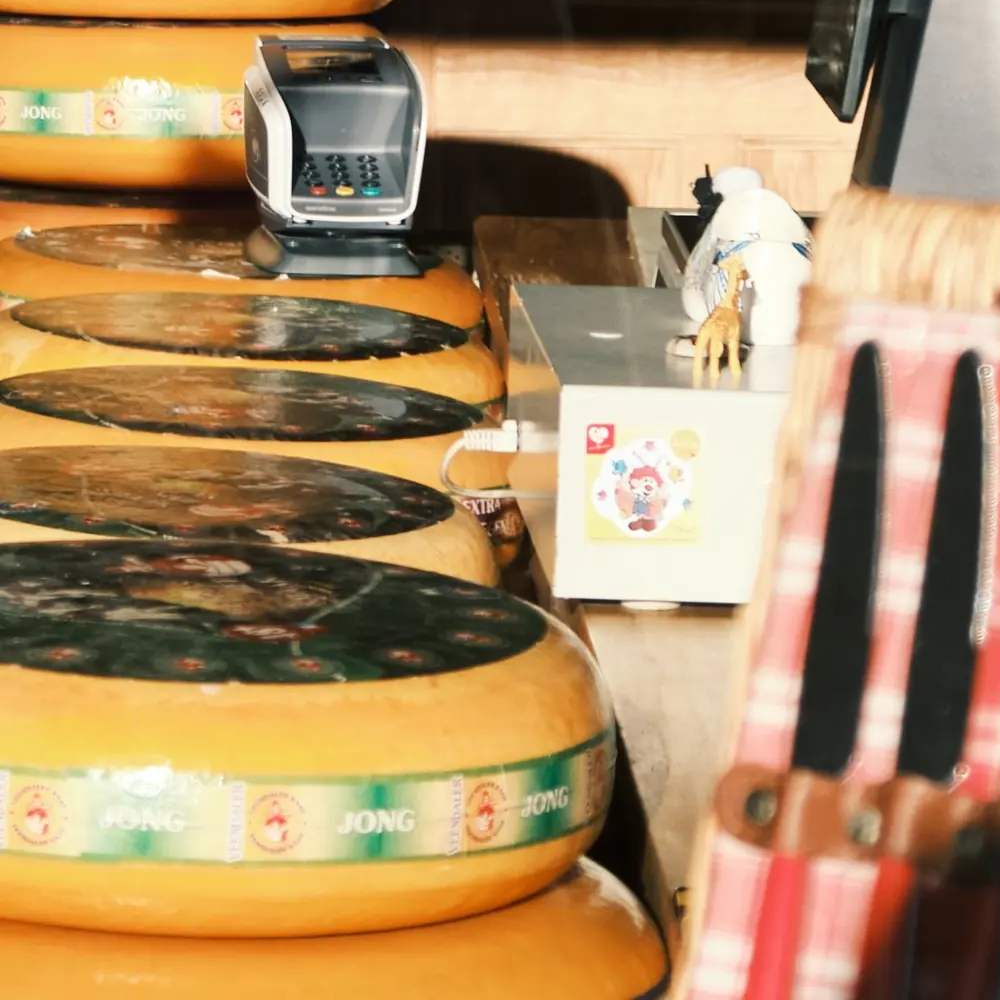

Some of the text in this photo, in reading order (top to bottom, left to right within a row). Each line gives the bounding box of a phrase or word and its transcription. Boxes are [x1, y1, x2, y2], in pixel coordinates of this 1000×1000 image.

[20, 105, 63, 120] JONG
[521, 786, 569, 817] JONG
[101, 804, 187, 833] JONG
[338, 808, 416, 836] JONG
